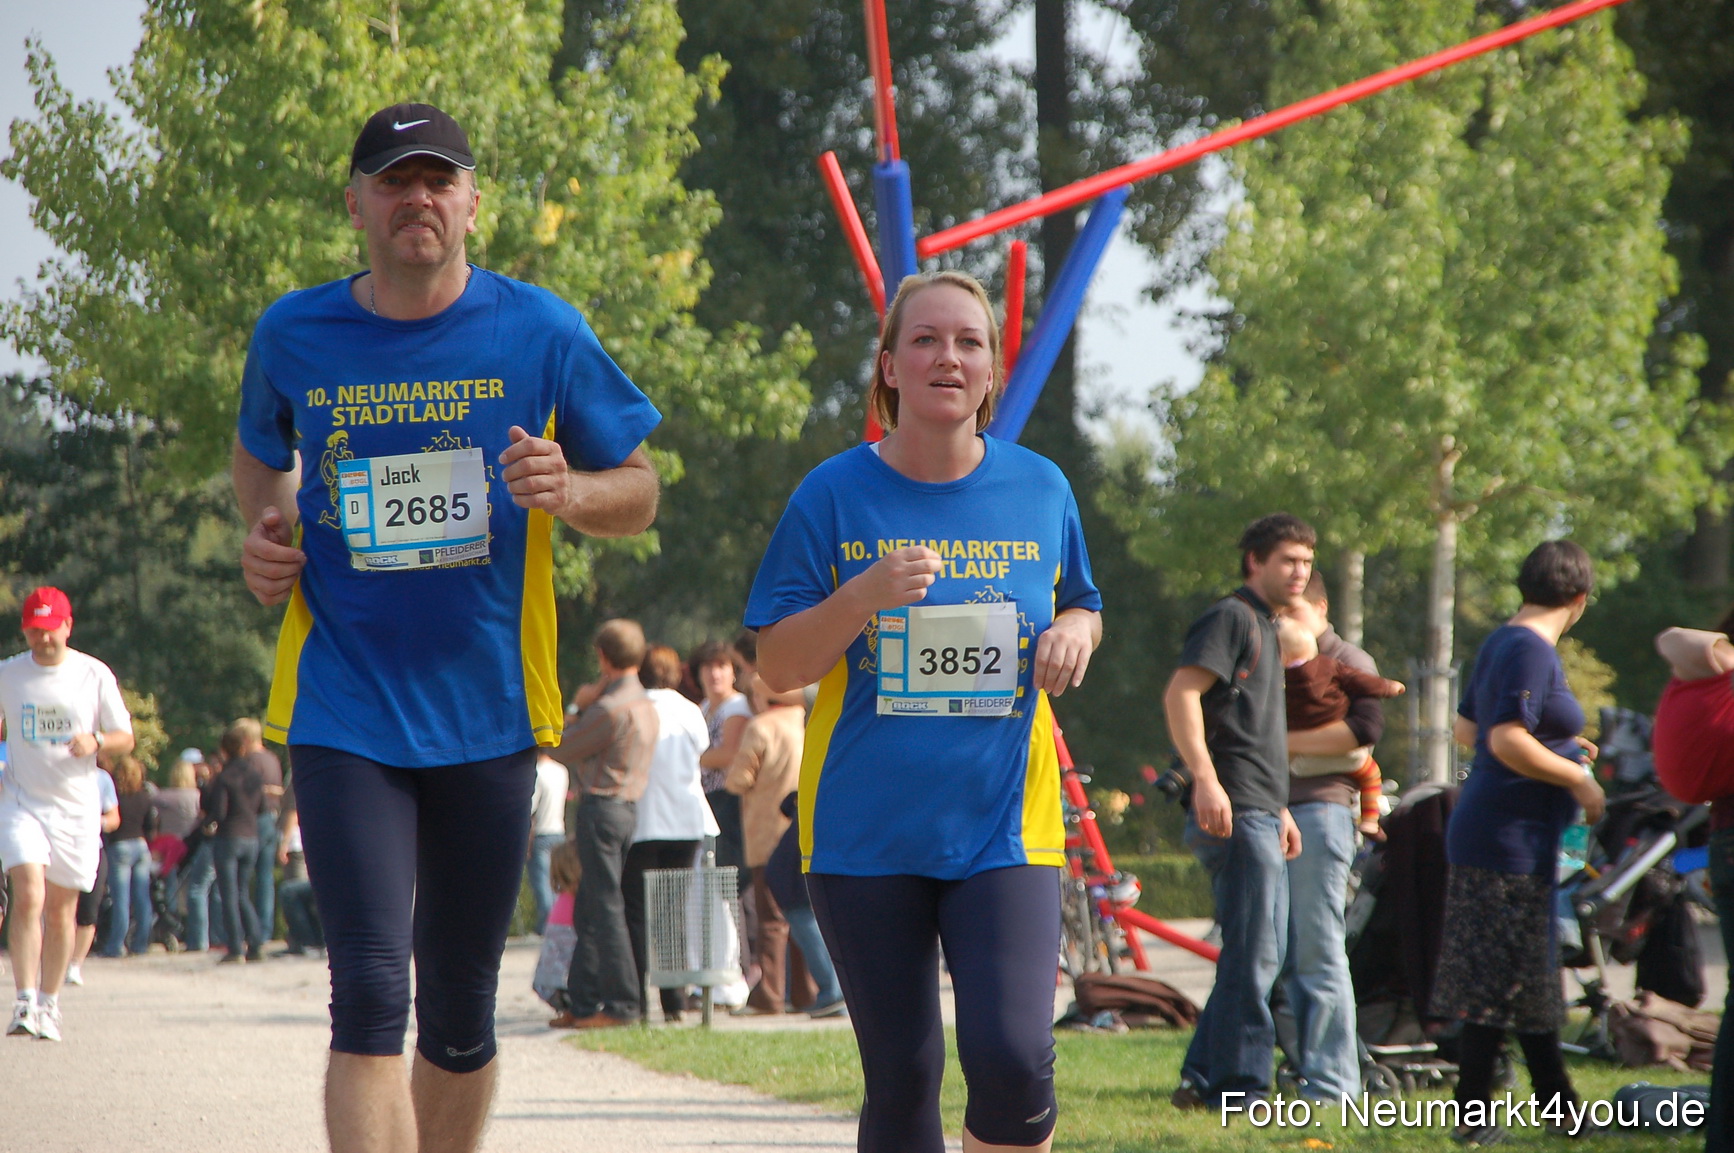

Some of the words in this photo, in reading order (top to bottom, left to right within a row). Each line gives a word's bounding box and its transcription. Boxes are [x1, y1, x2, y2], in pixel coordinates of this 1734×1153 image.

[306, 388, 332, 407] 10.
[337, 378, 505, 404] NEUMARKTER
[332, 402, 470, 426] STADTLAUF
[380, 463, 421, 486] Jack
[351, 500, 359, 515] D
[385, 492, 471, 528] 2685
[435, 540, 486, 557] PFLEIDERER
[841, 541, 872, 561] 10.
[877, 539, 1041, 561] NMARKTER
[938, 560, 1011, 579] TLAUF
[919, 647, 1002, 676] 3852
[39, 719, 71, 731] 3023
